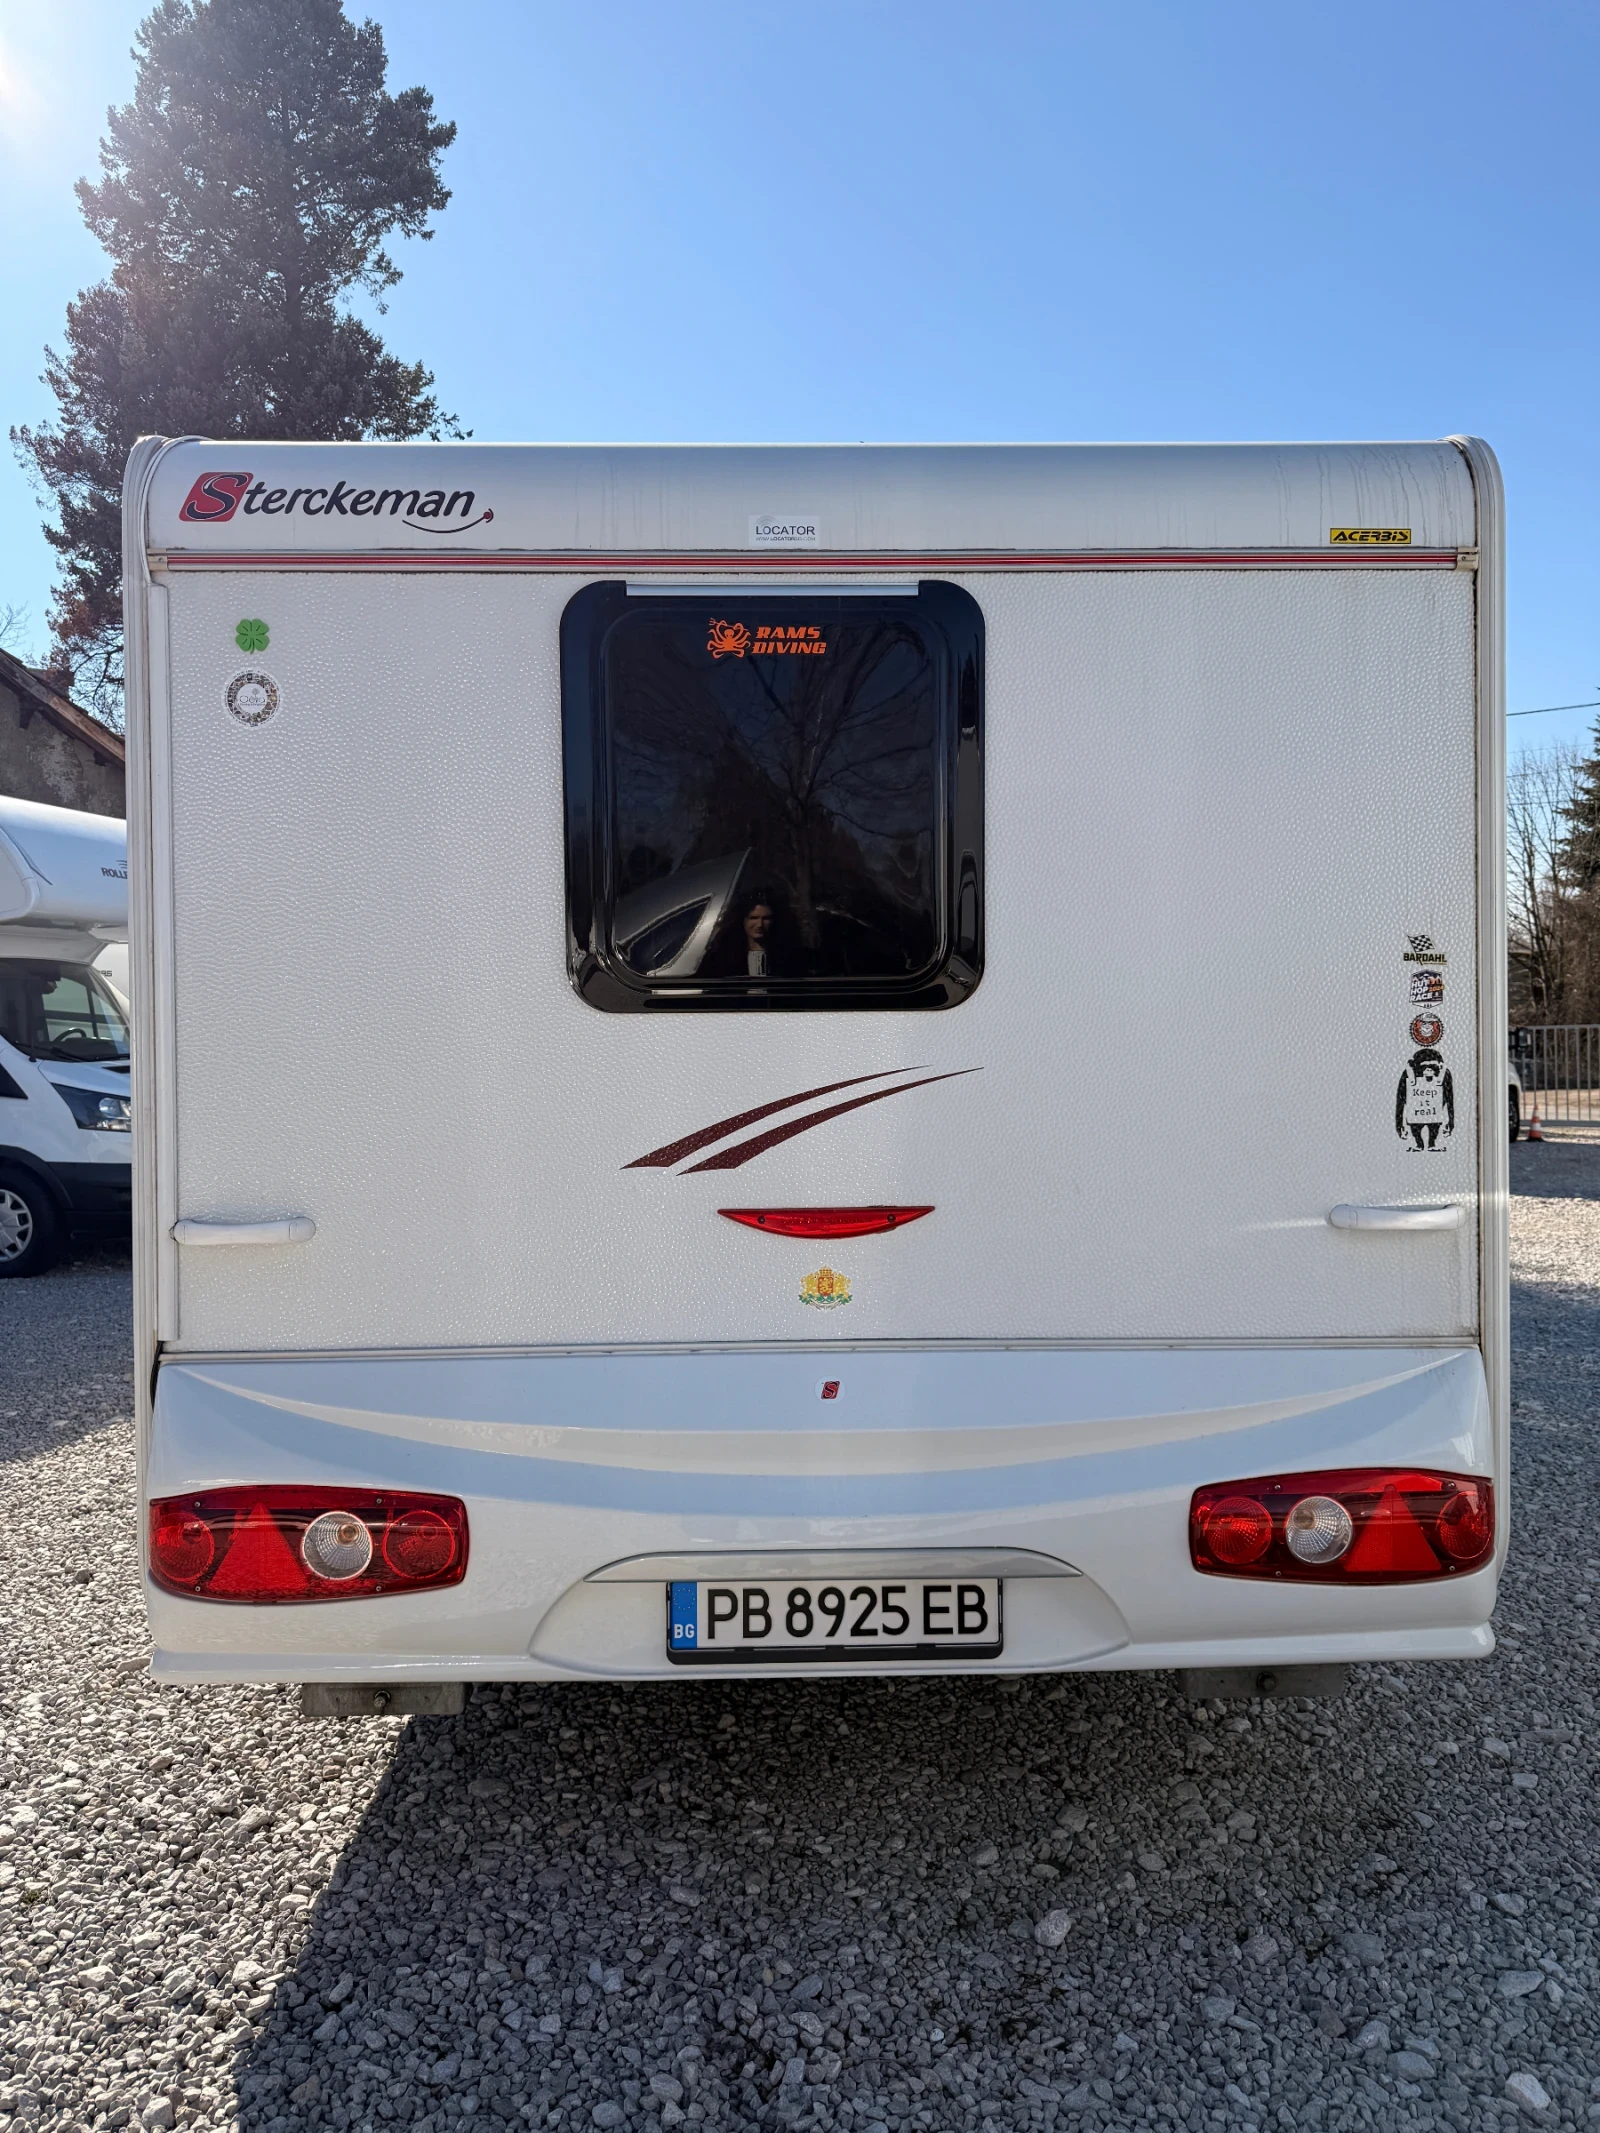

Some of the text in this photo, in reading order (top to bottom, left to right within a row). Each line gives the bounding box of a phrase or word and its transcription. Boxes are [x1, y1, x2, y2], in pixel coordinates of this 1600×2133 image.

[186, 473, 475, 519] Sterckeman
[755, 525, 816, 536] LOCATOR
[755, 626, 821, 639] RAMS
[751, 641, 827, 654] DIVING
[1403, 952, 1448, 963] BARDAHL
[1411, 979, 1429, 989] HUT
[1410, 986, 1429, 996] HOP
[1409, 992, 1433, 1002] RACE
[1412, 1088, 1437, 1098] Keep
[1414, 1107, 1436, 1116] real
[707, 1584, 989, 1640] PB 8925 EB
[673, 1624, 695, 1639] BG
